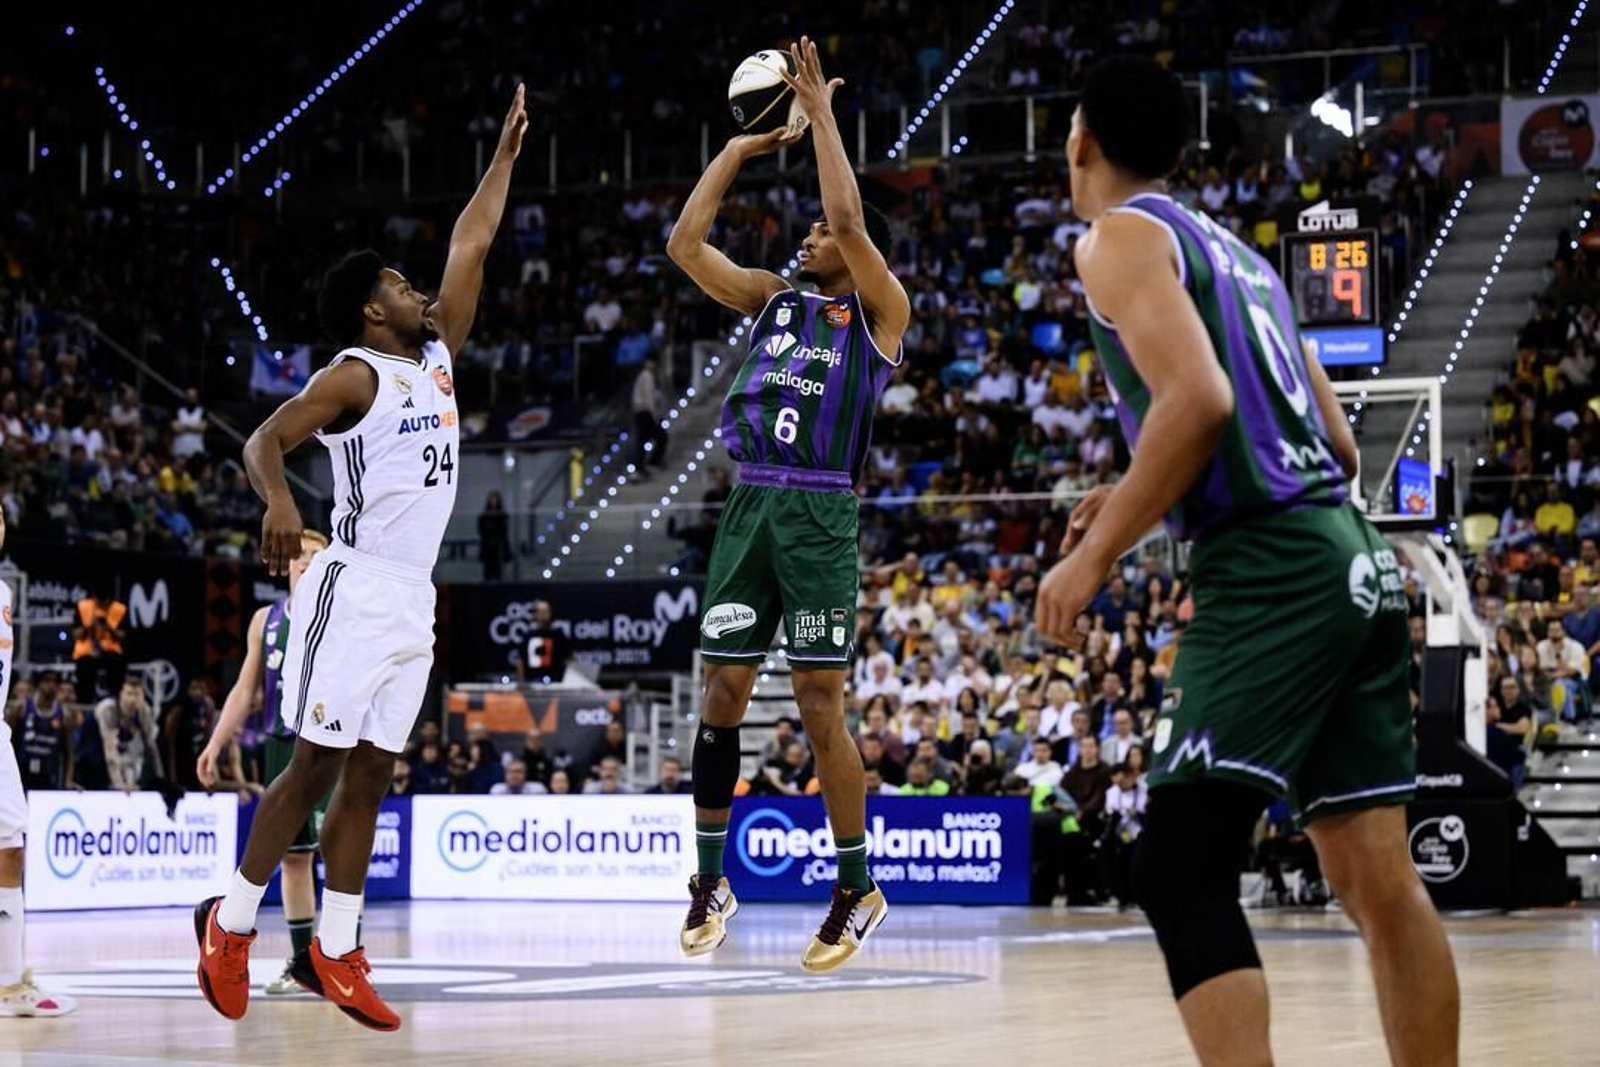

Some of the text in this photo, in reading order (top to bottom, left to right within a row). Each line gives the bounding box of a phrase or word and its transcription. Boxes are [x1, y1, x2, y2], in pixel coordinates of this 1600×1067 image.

[1298, 212, 1359, 232] LOTUS
[1335, 241, 1369, 269] 26
[1332, 269, 1363, 317] 9
[762, 368, 825, 397] málaga
[774, 406, 801, 444] 6
[422, 442, 454, 488] 24
[801, 609, 827, 628] má
[795, 626, 826, 642] laga
[943, 813, 1001, 829] BANCO
[54, 817, 217, 857] mediolanum
[450, 819, 681, 854] mediolanum
[873, 861, 1001, 883] son tus metas?
